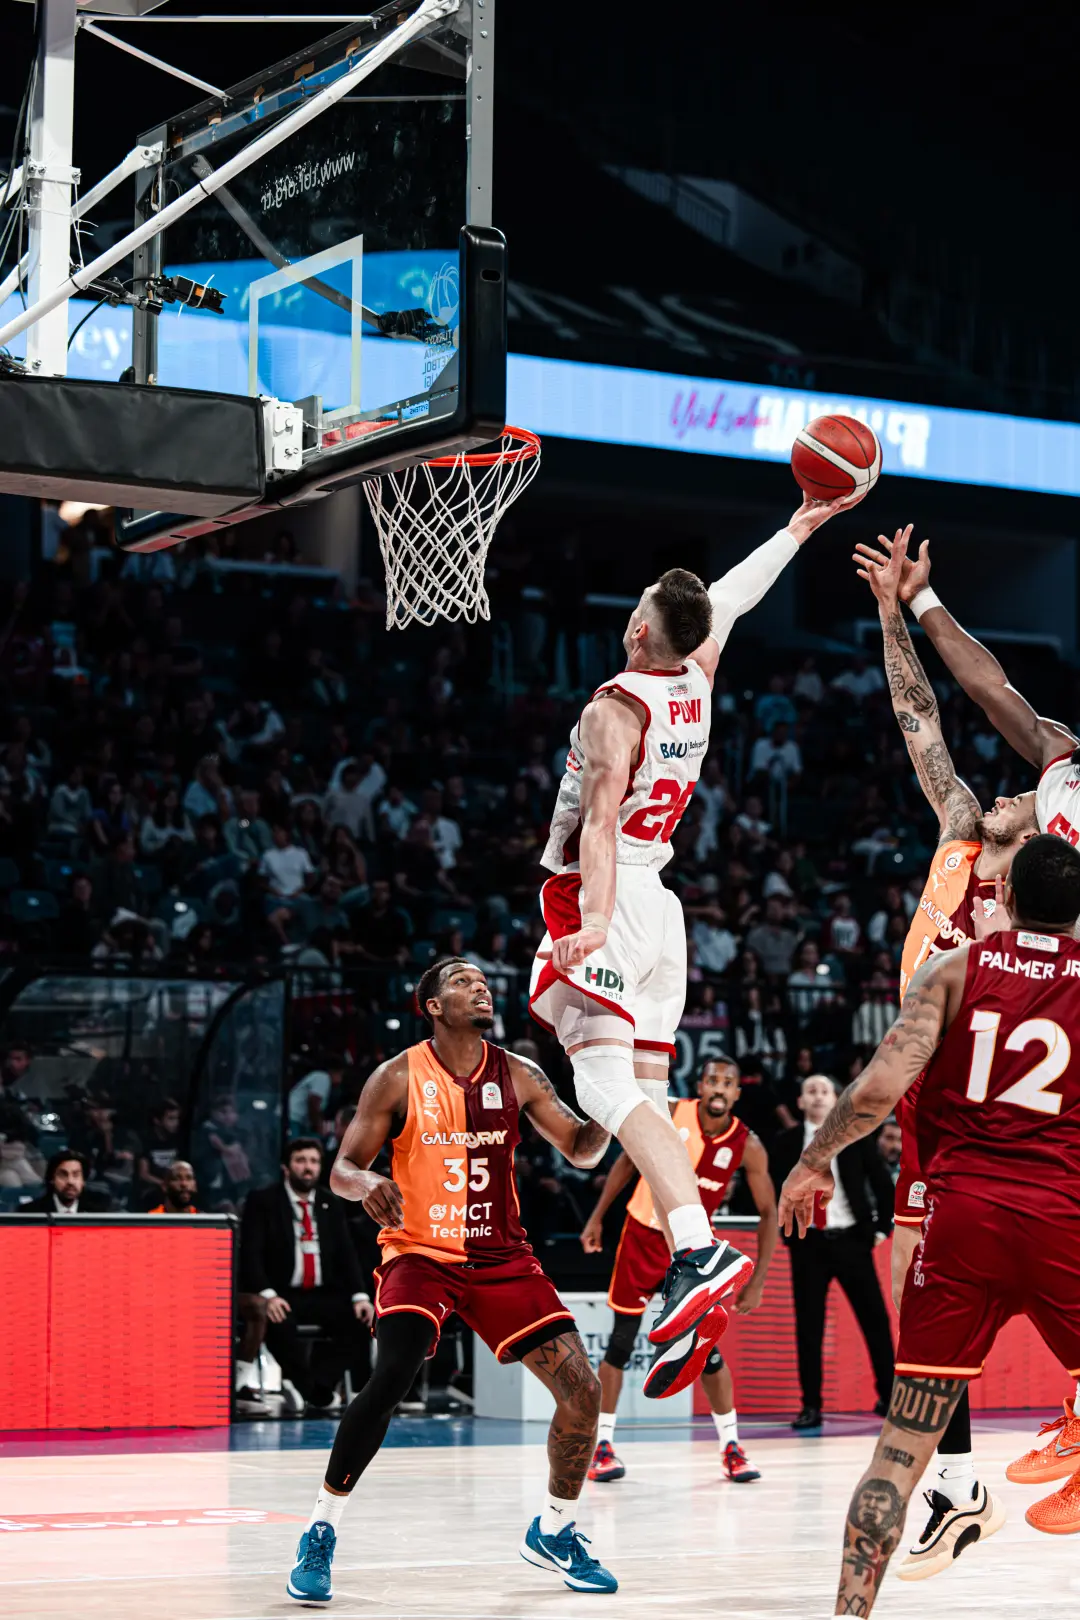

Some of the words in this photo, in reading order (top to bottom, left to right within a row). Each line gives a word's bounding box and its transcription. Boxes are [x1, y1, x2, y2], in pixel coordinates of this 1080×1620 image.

[660, 742, 687, 759] BAU
[979, 950, 1056, 980] PALMER
[1061, 959, 1080, 979] JR
[966, 1009, 1071, 1116] 12
[421, 1130, 508, 1149] GALATASARAY
[442, 1157, 490, 1193] 35
[450, 1202, 493, 1221] MCT
[430, 1223, 492, 1239] Technic
[892, 1381, 949, 1427] QUIT
